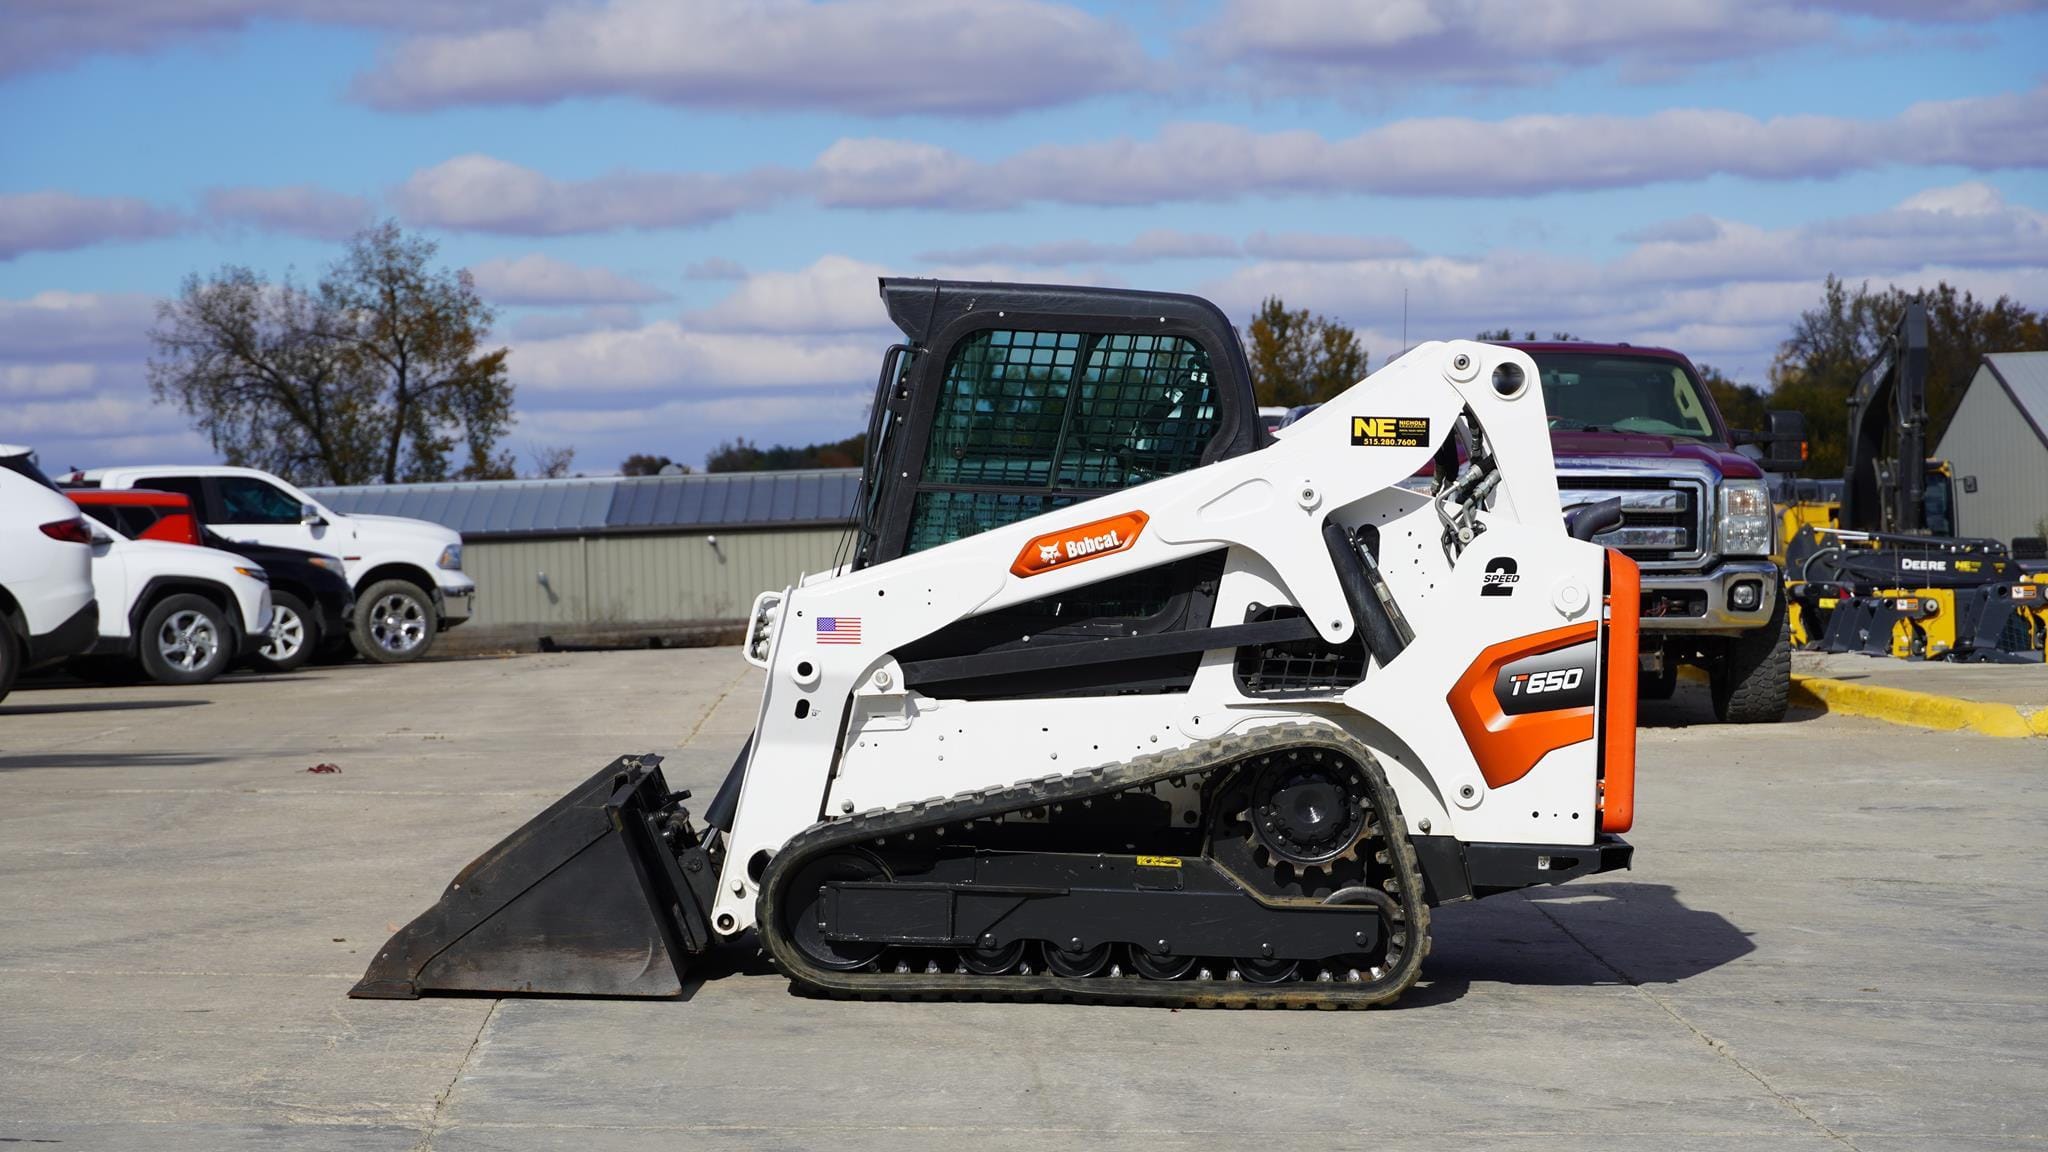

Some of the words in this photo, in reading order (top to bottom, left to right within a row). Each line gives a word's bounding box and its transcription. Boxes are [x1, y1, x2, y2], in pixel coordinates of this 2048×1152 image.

[1354, 418, 1396, 437] NE
[1364, 438, 1416, 446] 515.280.7600
[1065, 530, 1120, 559] Bobcat
[1902, 558, 1946, 571] DEERE
[1480, 556, 1517, 596] 2
[1483, 574, 1520, 583] SPEED
[1510, 668, 1583, 696] T650
